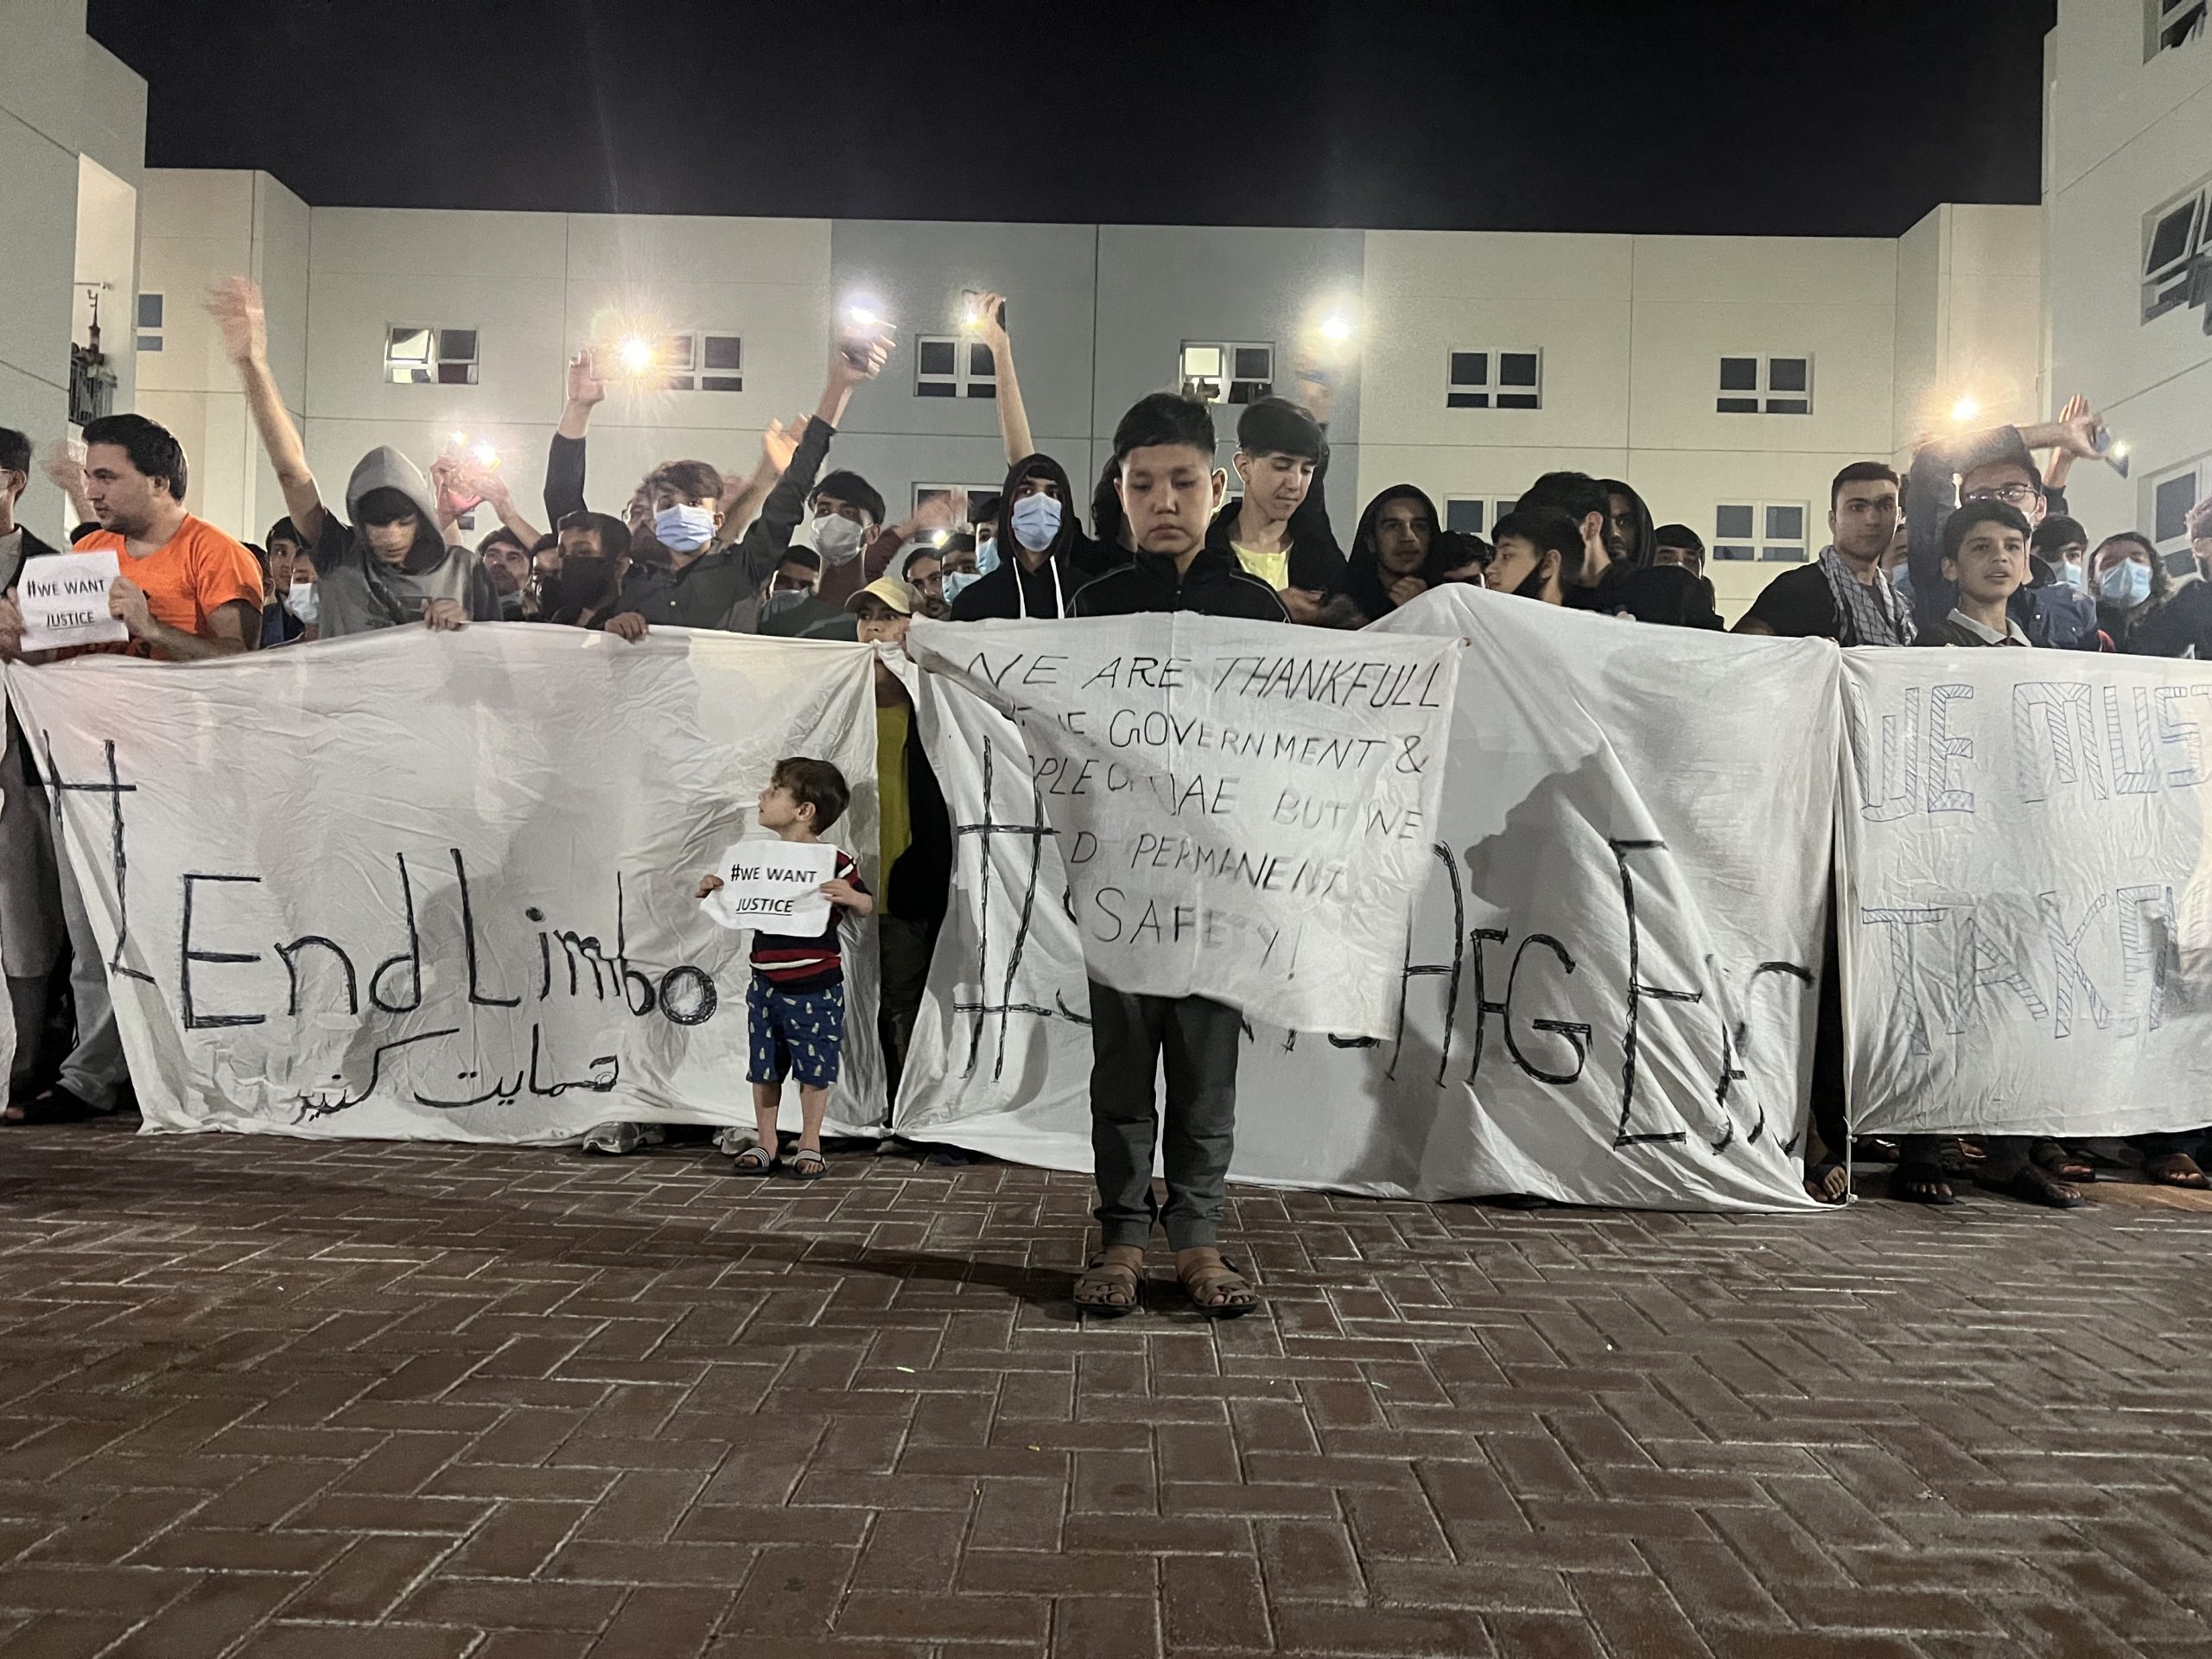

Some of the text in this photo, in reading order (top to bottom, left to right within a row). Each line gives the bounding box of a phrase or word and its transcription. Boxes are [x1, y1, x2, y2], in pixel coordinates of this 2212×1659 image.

[64, 579, 105, 595] WANT
[47, 611, 95, 628] JUSTICE
[1082, 657, 1192, 689] ARE
[1214, 657, 1440, 708] THANKFULL
[1109, 709, 1387, 770] GOVERNMENT
[1395, 735, 1430, 773] &
[1852, 682, 1975, 822] WE
[1273, 787, 1349, 832] BUT
[1364, 796, 1424, 840] WE
[731, 863, 817, 883] #WE WANT
[735, 898, 795, 913] JUSTICE
